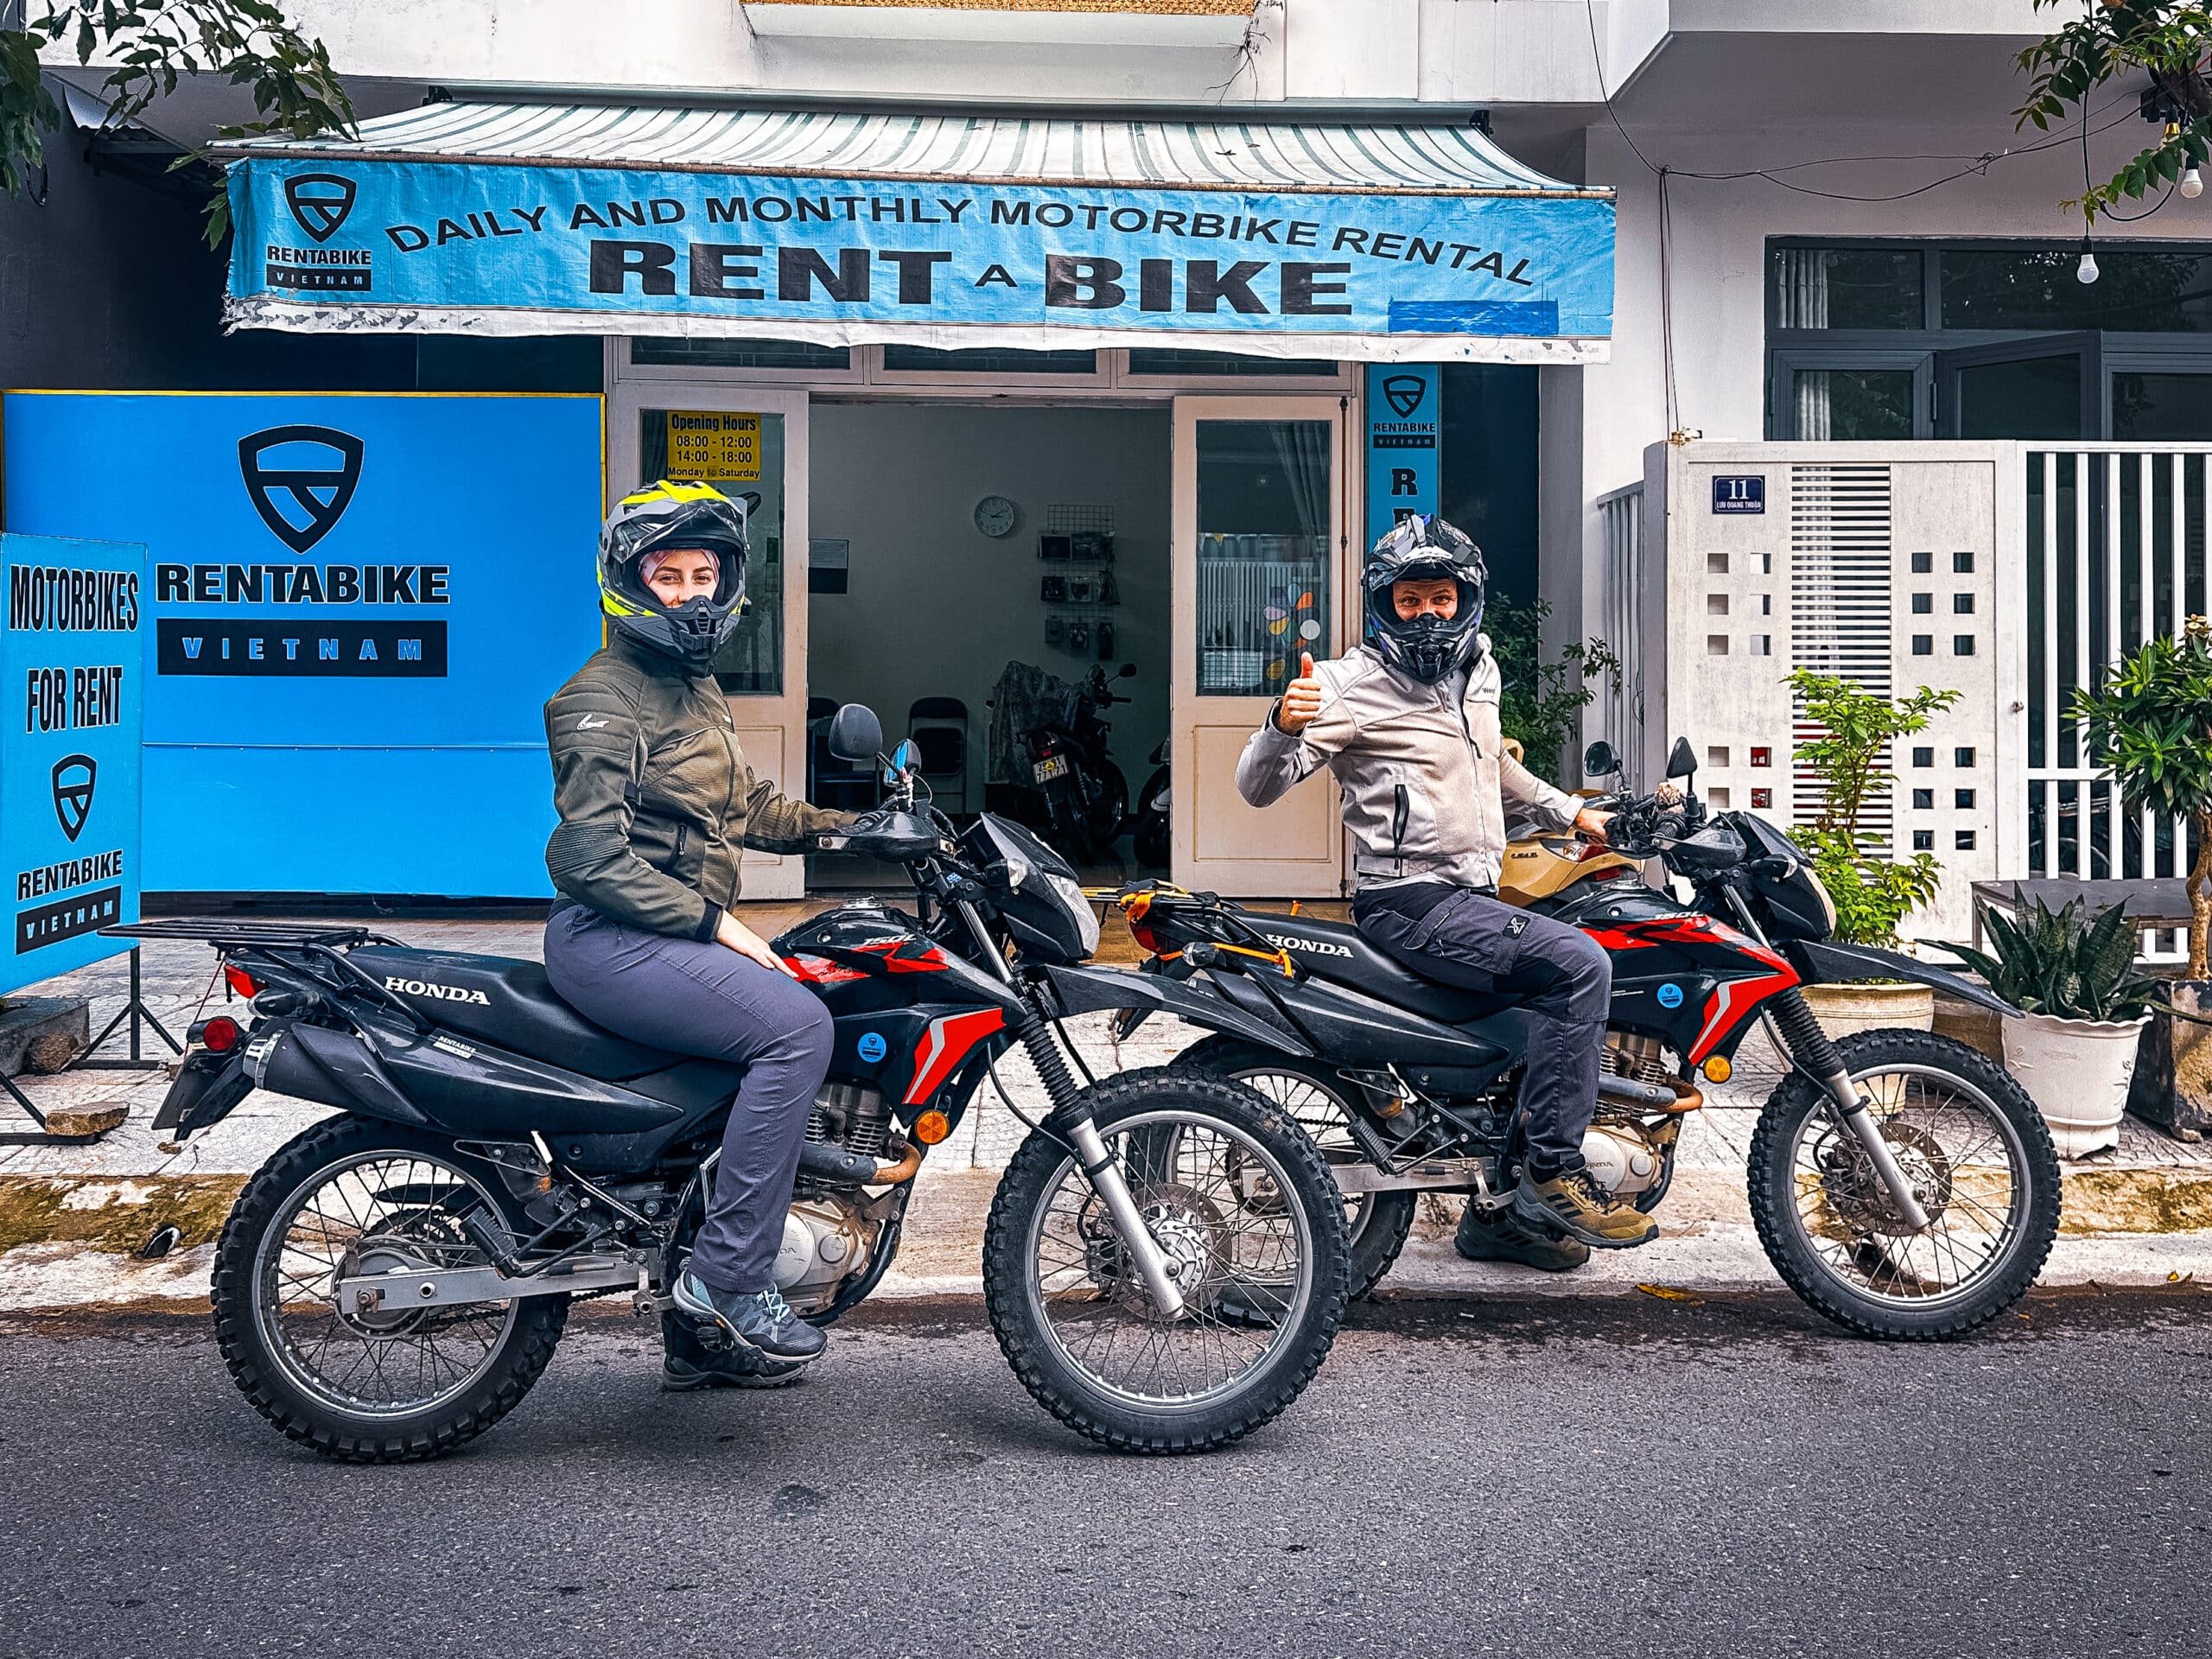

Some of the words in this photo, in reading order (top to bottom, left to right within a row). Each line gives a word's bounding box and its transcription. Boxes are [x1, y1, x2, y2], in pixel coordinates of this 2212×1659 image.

[385, 206, 547, 253] DAILY
[569, 198, 686, 230] AND
[706, 196, 972, 225] MONTHLY
[990, 200, 1321, 248] MOTORBIKE
[1332, 226, 1535, 286] RENTAL
[266, 245, 372, 266] RENTABIKE
[276, 272, 363, 285] VIETNAM
[589, 239, 952, 304] RENT
[974, 264, 1019, 288] A
[1046, 254, 1352, 315] BIKE
[671, 414, 719, 431] Opening
[723, 415, 756, 430] Hours
[1372, 422, 1436, 433] RENTABIKE
[677, 435, 709, 447] 08:00
[721, 436, 752, 448] 12:00
[677, 450, 709, 462] 14:00
[721, 451, 752, 463] 18:00
[668, 467, 704, 480] Monday
[719, 467, 760, 479] Saturday
[1729, 480, 1749, 499] 11
[156, 563, 450, 604] RENTABIKE
[9, 564, 138, 632] MOTORBIKES
[182, 637, 422, 661] VIETNAM
[27, 667, 67, 734] FOR
[73, 665, 123, 730] RENT
[17, 849, 123, 901] RENTABIKE
[26, 899, 113, 939] VIETNAM
[1265, 933, 1354, 958] HONDA
[385, 976, 491, 1006] HONDA
